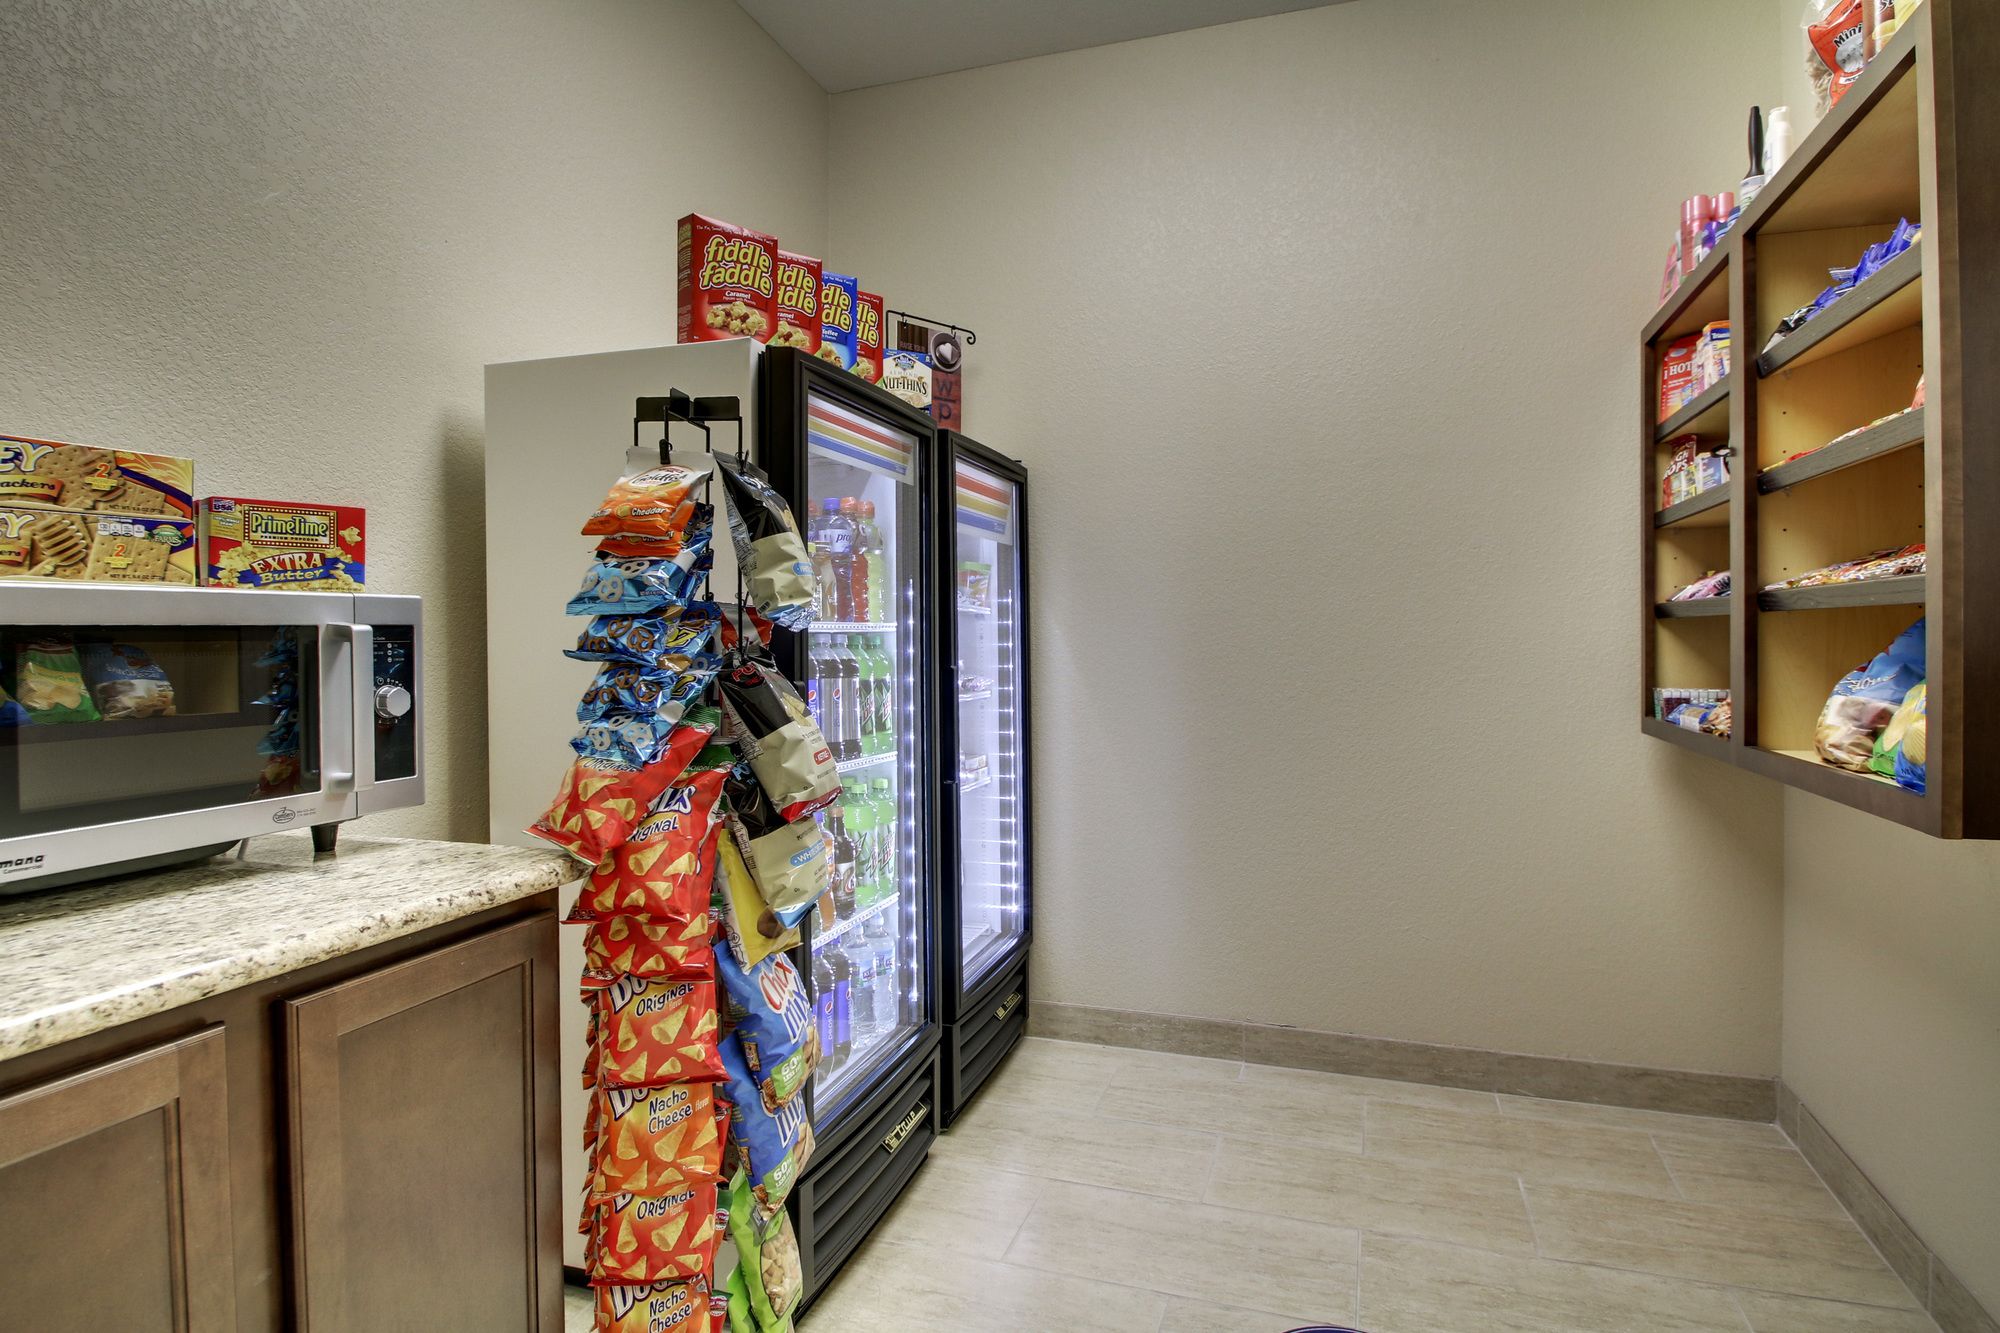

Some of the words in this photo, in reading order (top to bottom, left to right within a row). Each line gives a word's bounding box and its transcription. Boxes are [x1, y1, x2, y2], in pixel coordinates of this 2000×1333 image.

[706, 236, 770, 273] fiddle
[701, 261, 772, 296] faddle
[725, 290, 751, 300] Caramel
[96, 463, 110, 478] 2
[632, 507, 667, 516] Cheddar
[251, 513, 328, 538] PrimeTime
[114, 545, 126, 558] 2
[251, 552, 323, 574] EXTRA
[259, 568, 324, 584] Butter
[648, 1089, 689, 1116] Nacho
[648, 1104, 692, 1135] Cheese
[649, 1290, 687, 1318] Nacho
[649, 1303, 693, 1333] Cheese
